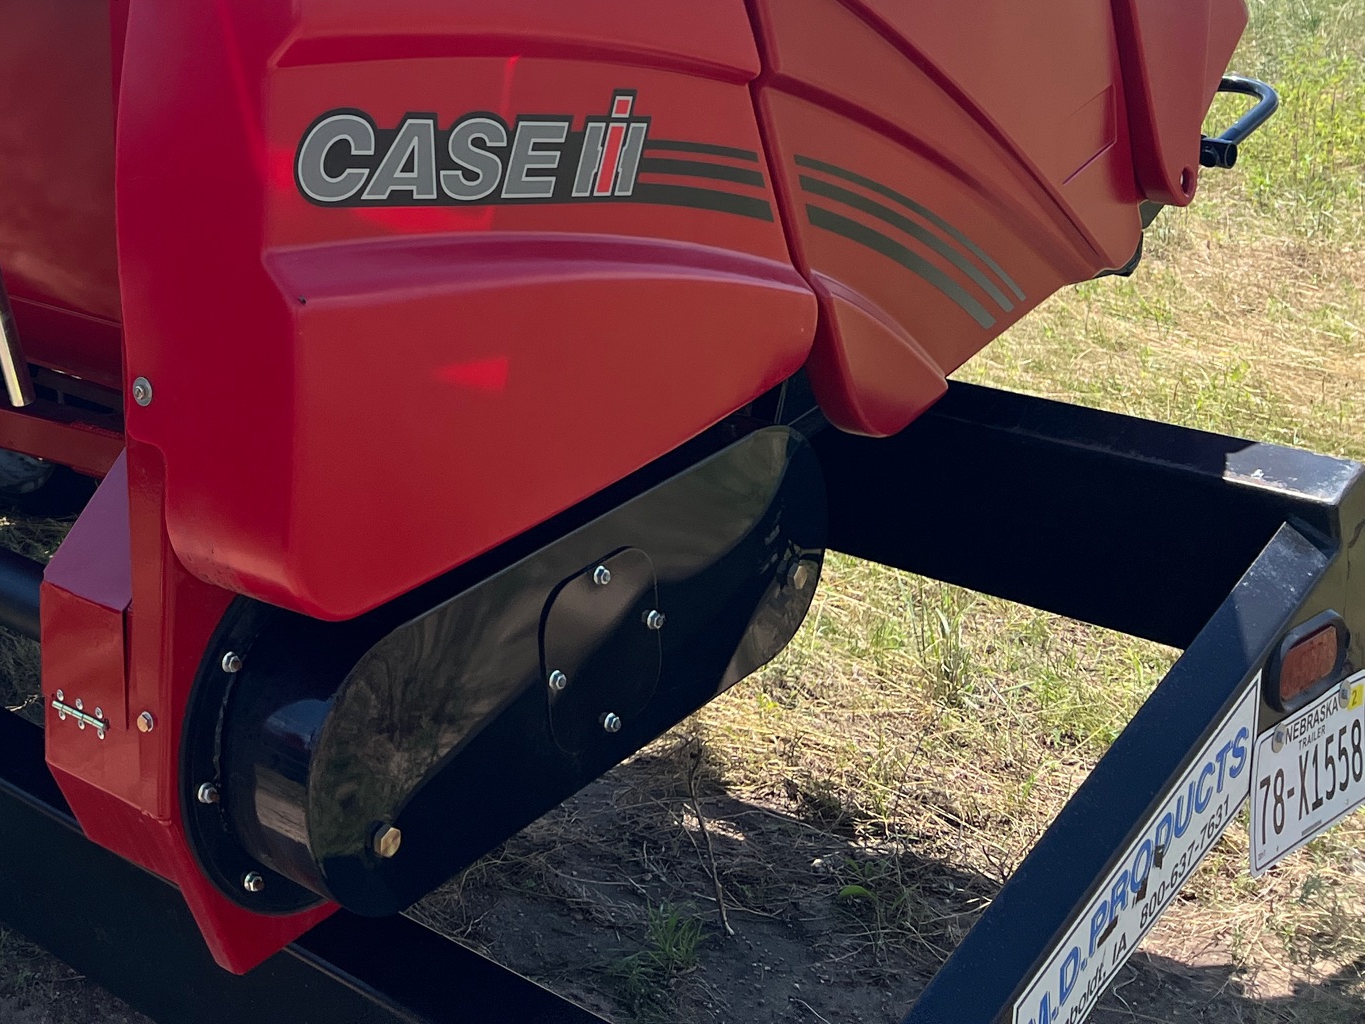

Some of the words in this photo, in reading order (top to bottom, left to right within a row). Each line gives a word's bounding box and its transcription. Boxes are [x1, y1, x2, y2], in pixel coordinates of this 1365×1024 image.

[297, 114, 570, 202] CASE
[1286, 696, 1339, 745] NEBRASKA
[1298, 724, 1326, 751] TRAILER
[1259, 718, 1364, 845] 78-X1558
[1088, 726, 1250, 959] PRODUCTS
[1140, 794, 1230, 929] 800-637-7631
